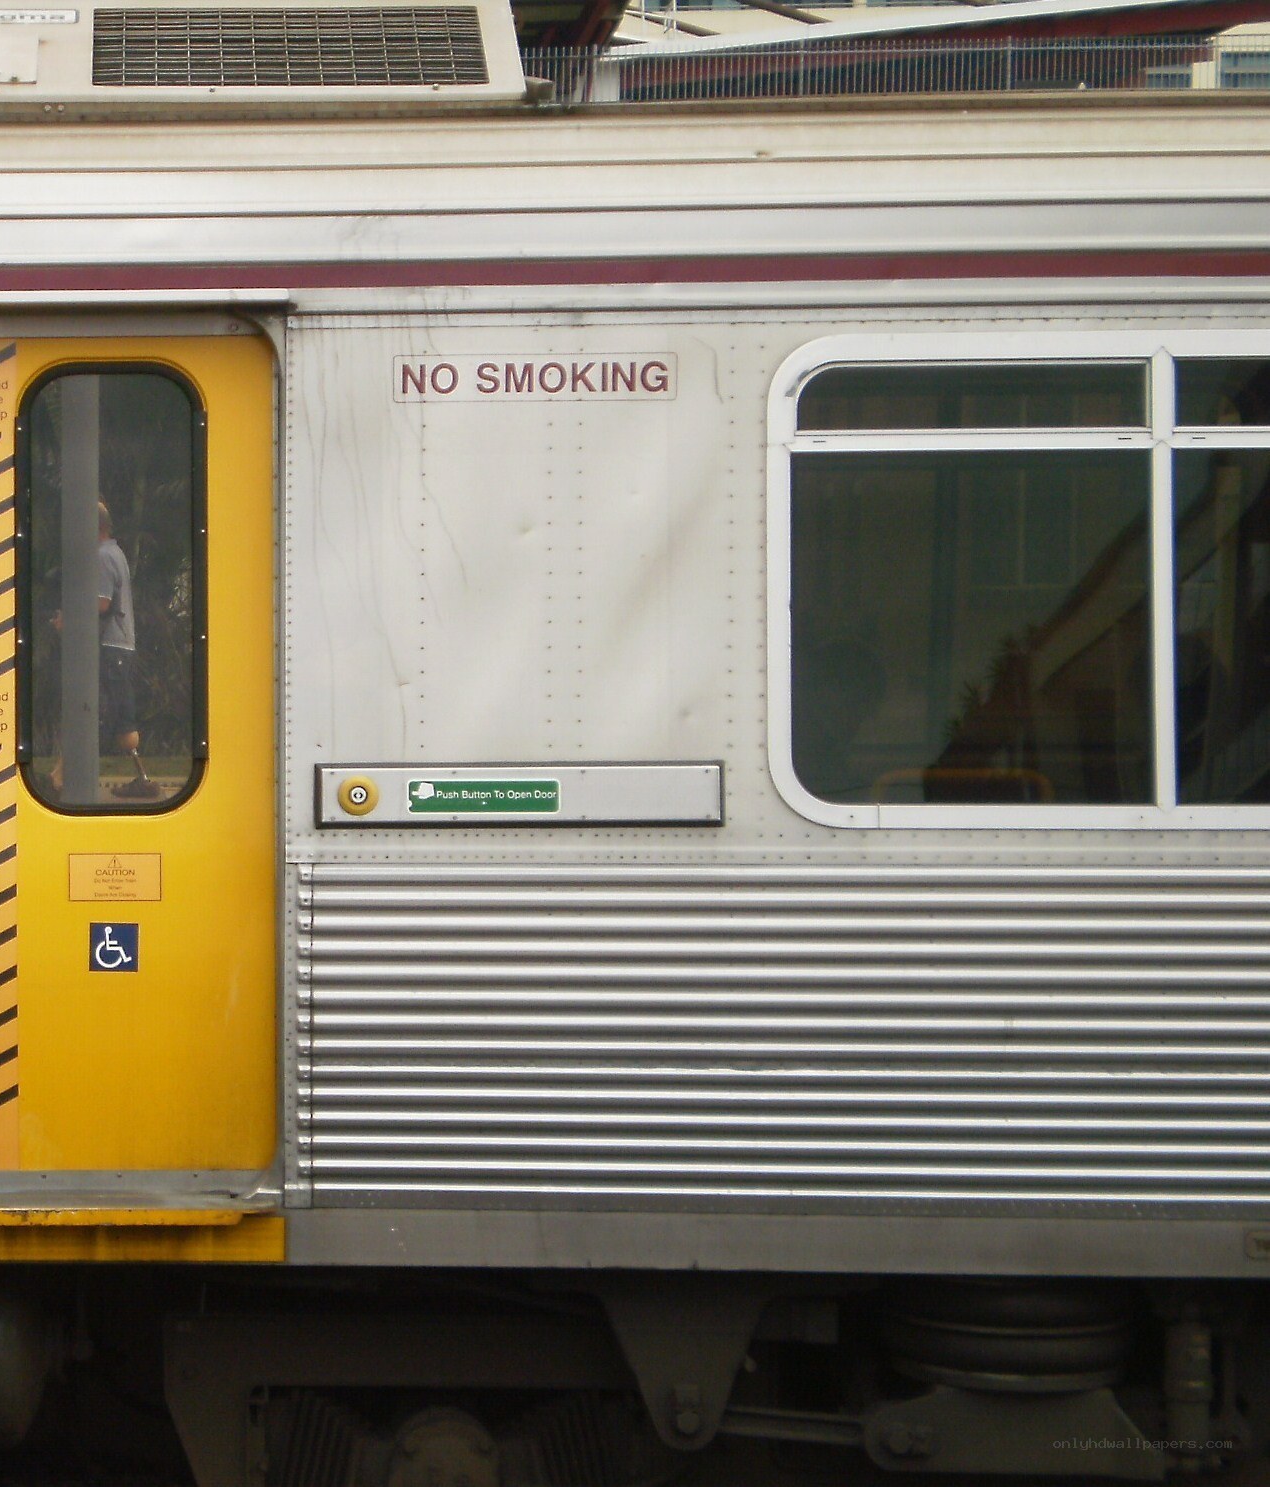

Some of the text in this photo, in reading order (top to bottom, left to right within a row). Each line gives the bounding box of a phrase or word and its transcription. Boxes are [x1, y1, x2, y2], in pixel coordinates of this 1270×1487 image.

[401, 360, 669, 394] NO SMOKING
[436, 790, 557, 800] Push Button To Open Door
